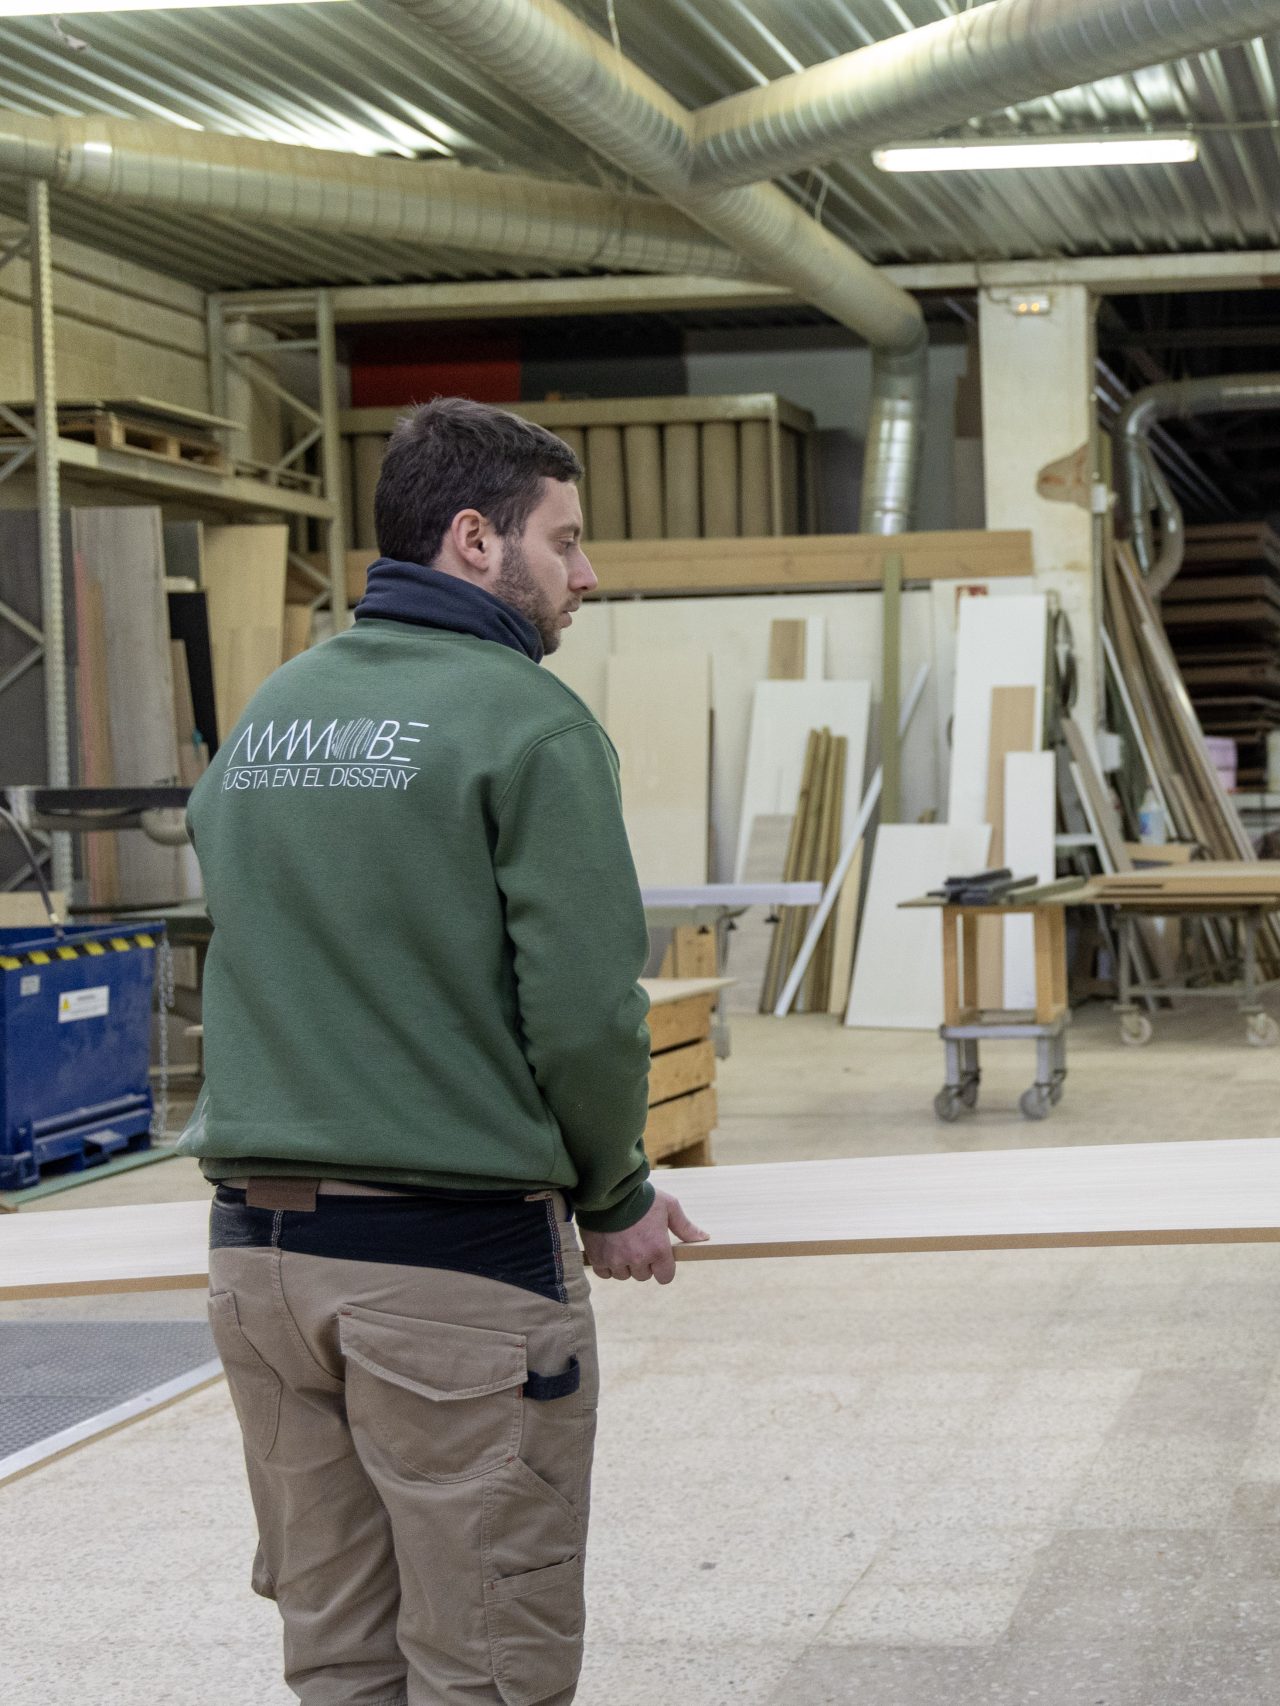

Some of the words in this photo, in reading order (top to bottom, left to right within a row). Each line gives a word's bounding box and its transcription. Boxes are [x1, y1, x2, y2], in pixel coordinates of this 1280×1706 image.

[272, 768, 301, 788] EN
[302, 767, 325, 788] EL
[328, 767, 418, 791] DISSENY
